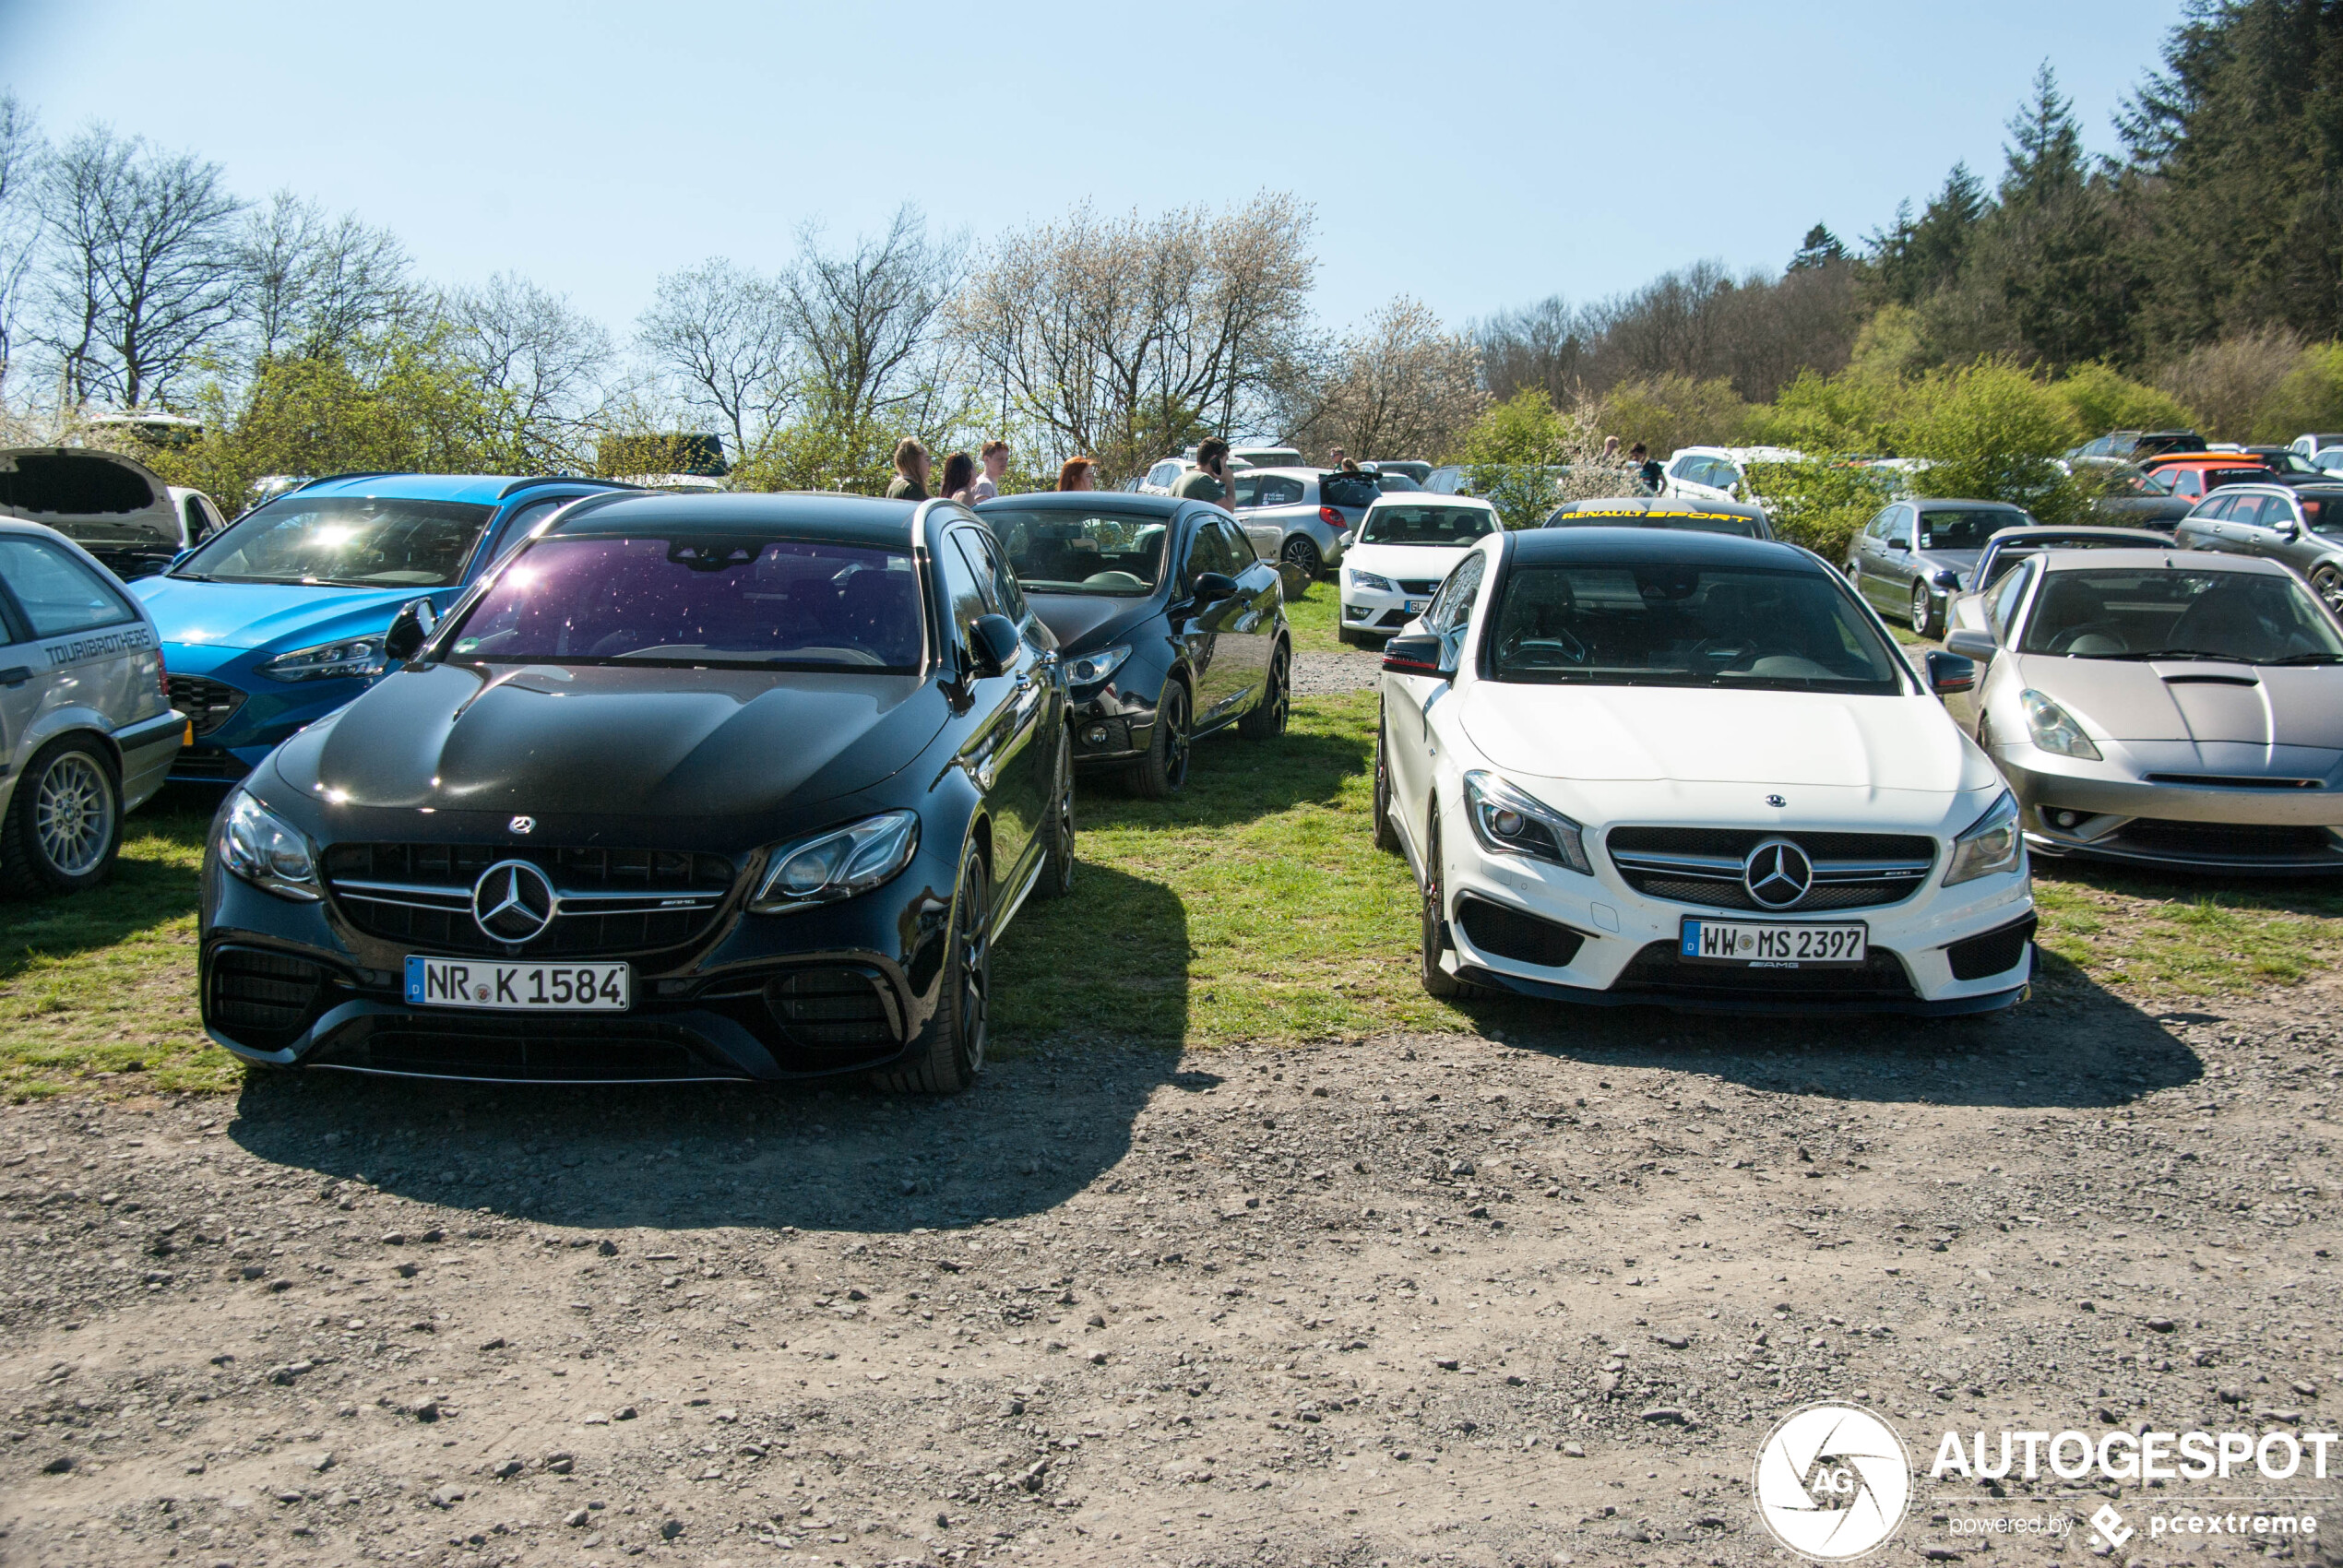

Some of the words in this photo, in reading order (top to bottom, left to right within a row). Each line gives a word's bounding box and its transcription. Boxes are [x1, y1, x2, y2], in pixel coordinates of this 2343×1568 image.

[1562, 510, 1646, 520] RENAULT
[1646, 511, 1753, 524] SPORT
[45, 628, 150, 665] TOURIBROTHERS
[1687, 943, 1695, 951] D
[1704, 927, 1738, 956] WW
[1757, 930, 1790, 958] MS
[1796, 931, 1861, 958] 2397
[412, 984, 420, 994] D
[427, 964, 471, 1001] NR
[496, 968, 518, 1004] K
[529, 969, 621, 1004] 1584
